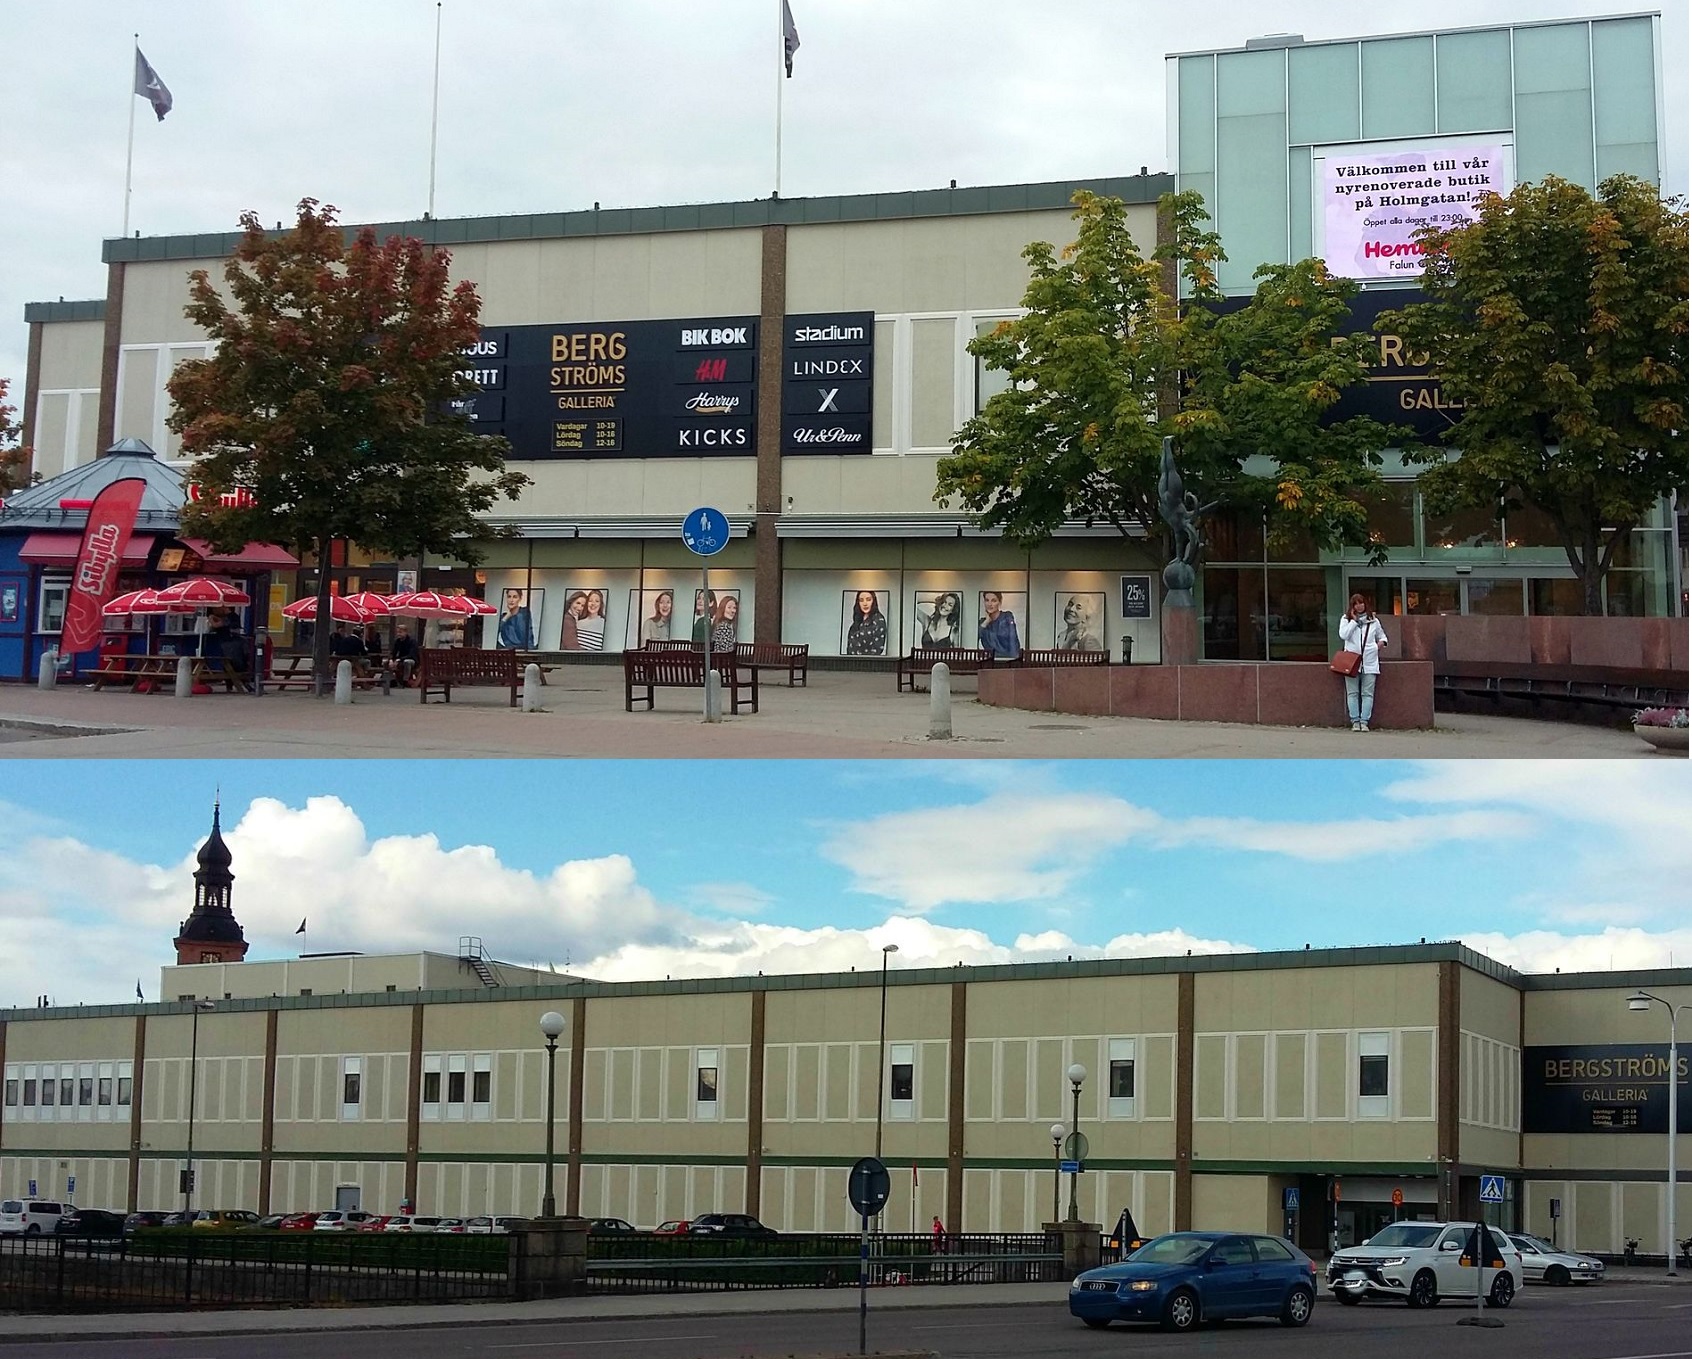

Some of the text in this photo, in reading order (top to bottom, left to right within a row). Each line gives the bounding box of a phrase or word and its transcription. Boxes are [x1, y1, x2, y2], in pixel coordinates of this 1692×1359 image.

[1336, 156, 1489, 178] Välkommen till vår
[1335, 174, 1491, 196] nyrenoverade butik
[1355, 191, 1472, 211] på Holmgatan!
[1363, 217, 1387, 228] Öppet
[1390, 216, 1403, 225] alla
[1389, 260, 1414, 270] Falun
[681, 327, 747, 346] BIK BOK
[795, 325, 863, 342] stadium
[552, 332, 627, 362] BERG
[550, 362, 626, 386] STRÖMS
[794, 360, 862, 375] LINDEX
[558, 396, 615, 409] GALLERIA
[685, 392, 739, 414] Harrys
[556, 423, 588, 431] Vardagar
[556, 431, 581, 440] Lördag
[556, 440, 583, 448] Söndag
[679, 429, 746, 446] KICKS
[78, 524, 120, 595] Sibylla
[1127, 584, 1146, 601] 25%
[1545, 1054, 1689, 1078] BERGSTRÖMS
[1582, 1089, 1648, 1101] GALLERIA
